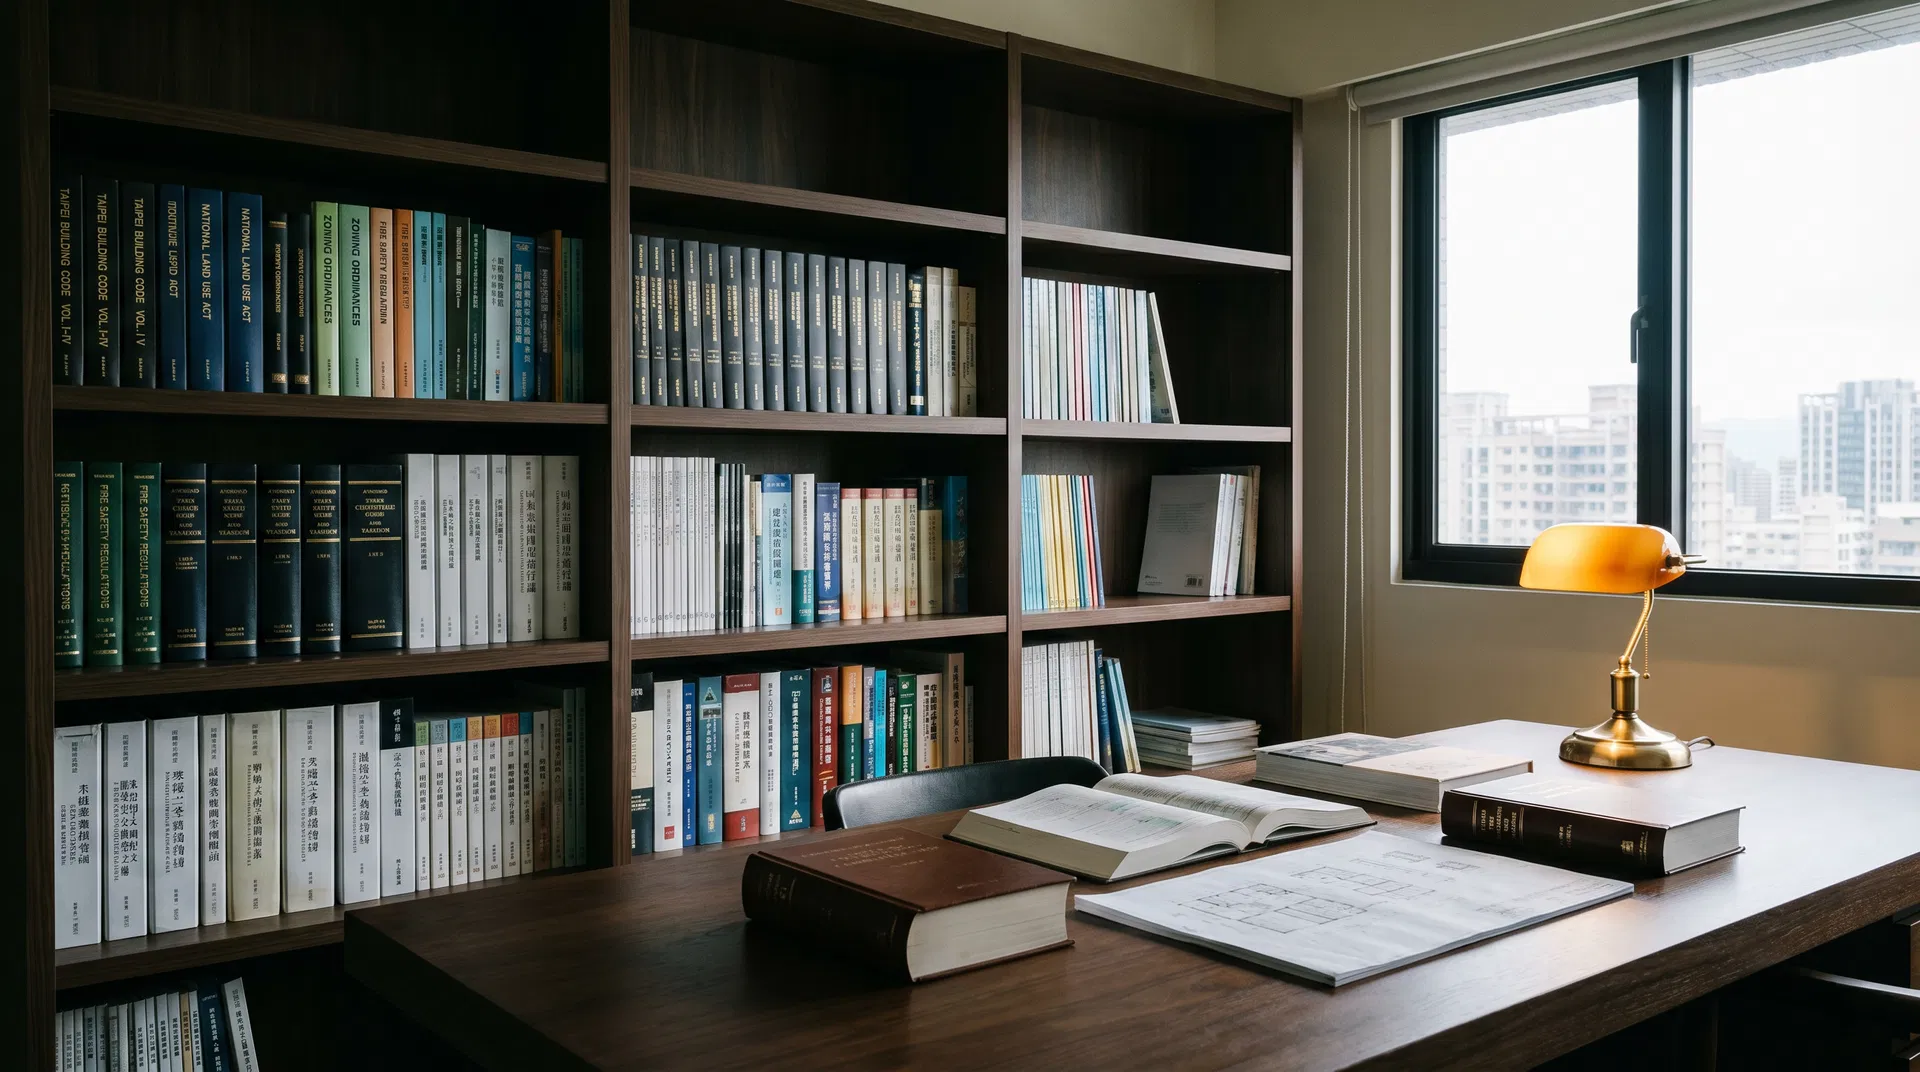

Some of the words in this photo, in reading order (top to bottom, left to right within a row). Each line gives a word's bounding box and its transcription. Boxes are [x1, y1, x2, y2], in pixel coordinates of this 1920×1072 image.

[59, 188, 71, 218] TAIPEI
[97, 193, 107, 223] TAIPEI
[134, 197, 144, 227] TAIPEI
[201, 203, 211, 250] NATIONAL
[241, 207, 251, 253] NATIONAL
[323, 214, 333, 254] ZONING
[60, 221, 71, 266] BUILDING
[97, 226, 108, 270] BUILDING
[134, 230, 145, 274] BUILDING
[201, 253, 211, 278] LAND
[241, 256, 251, 280] LAND
[60, 269, 71, 296] CODE
[97, 274, 108, 300] CODE
[135, 277, 145, 303] CODE
[169, 278, 179, 298] ACT
[201, 281, 212, 298] USE
[241, 283, 251, 301] USE
[202, 301, 212, 320] ACT
[242, 304, 251, 323] ACT
